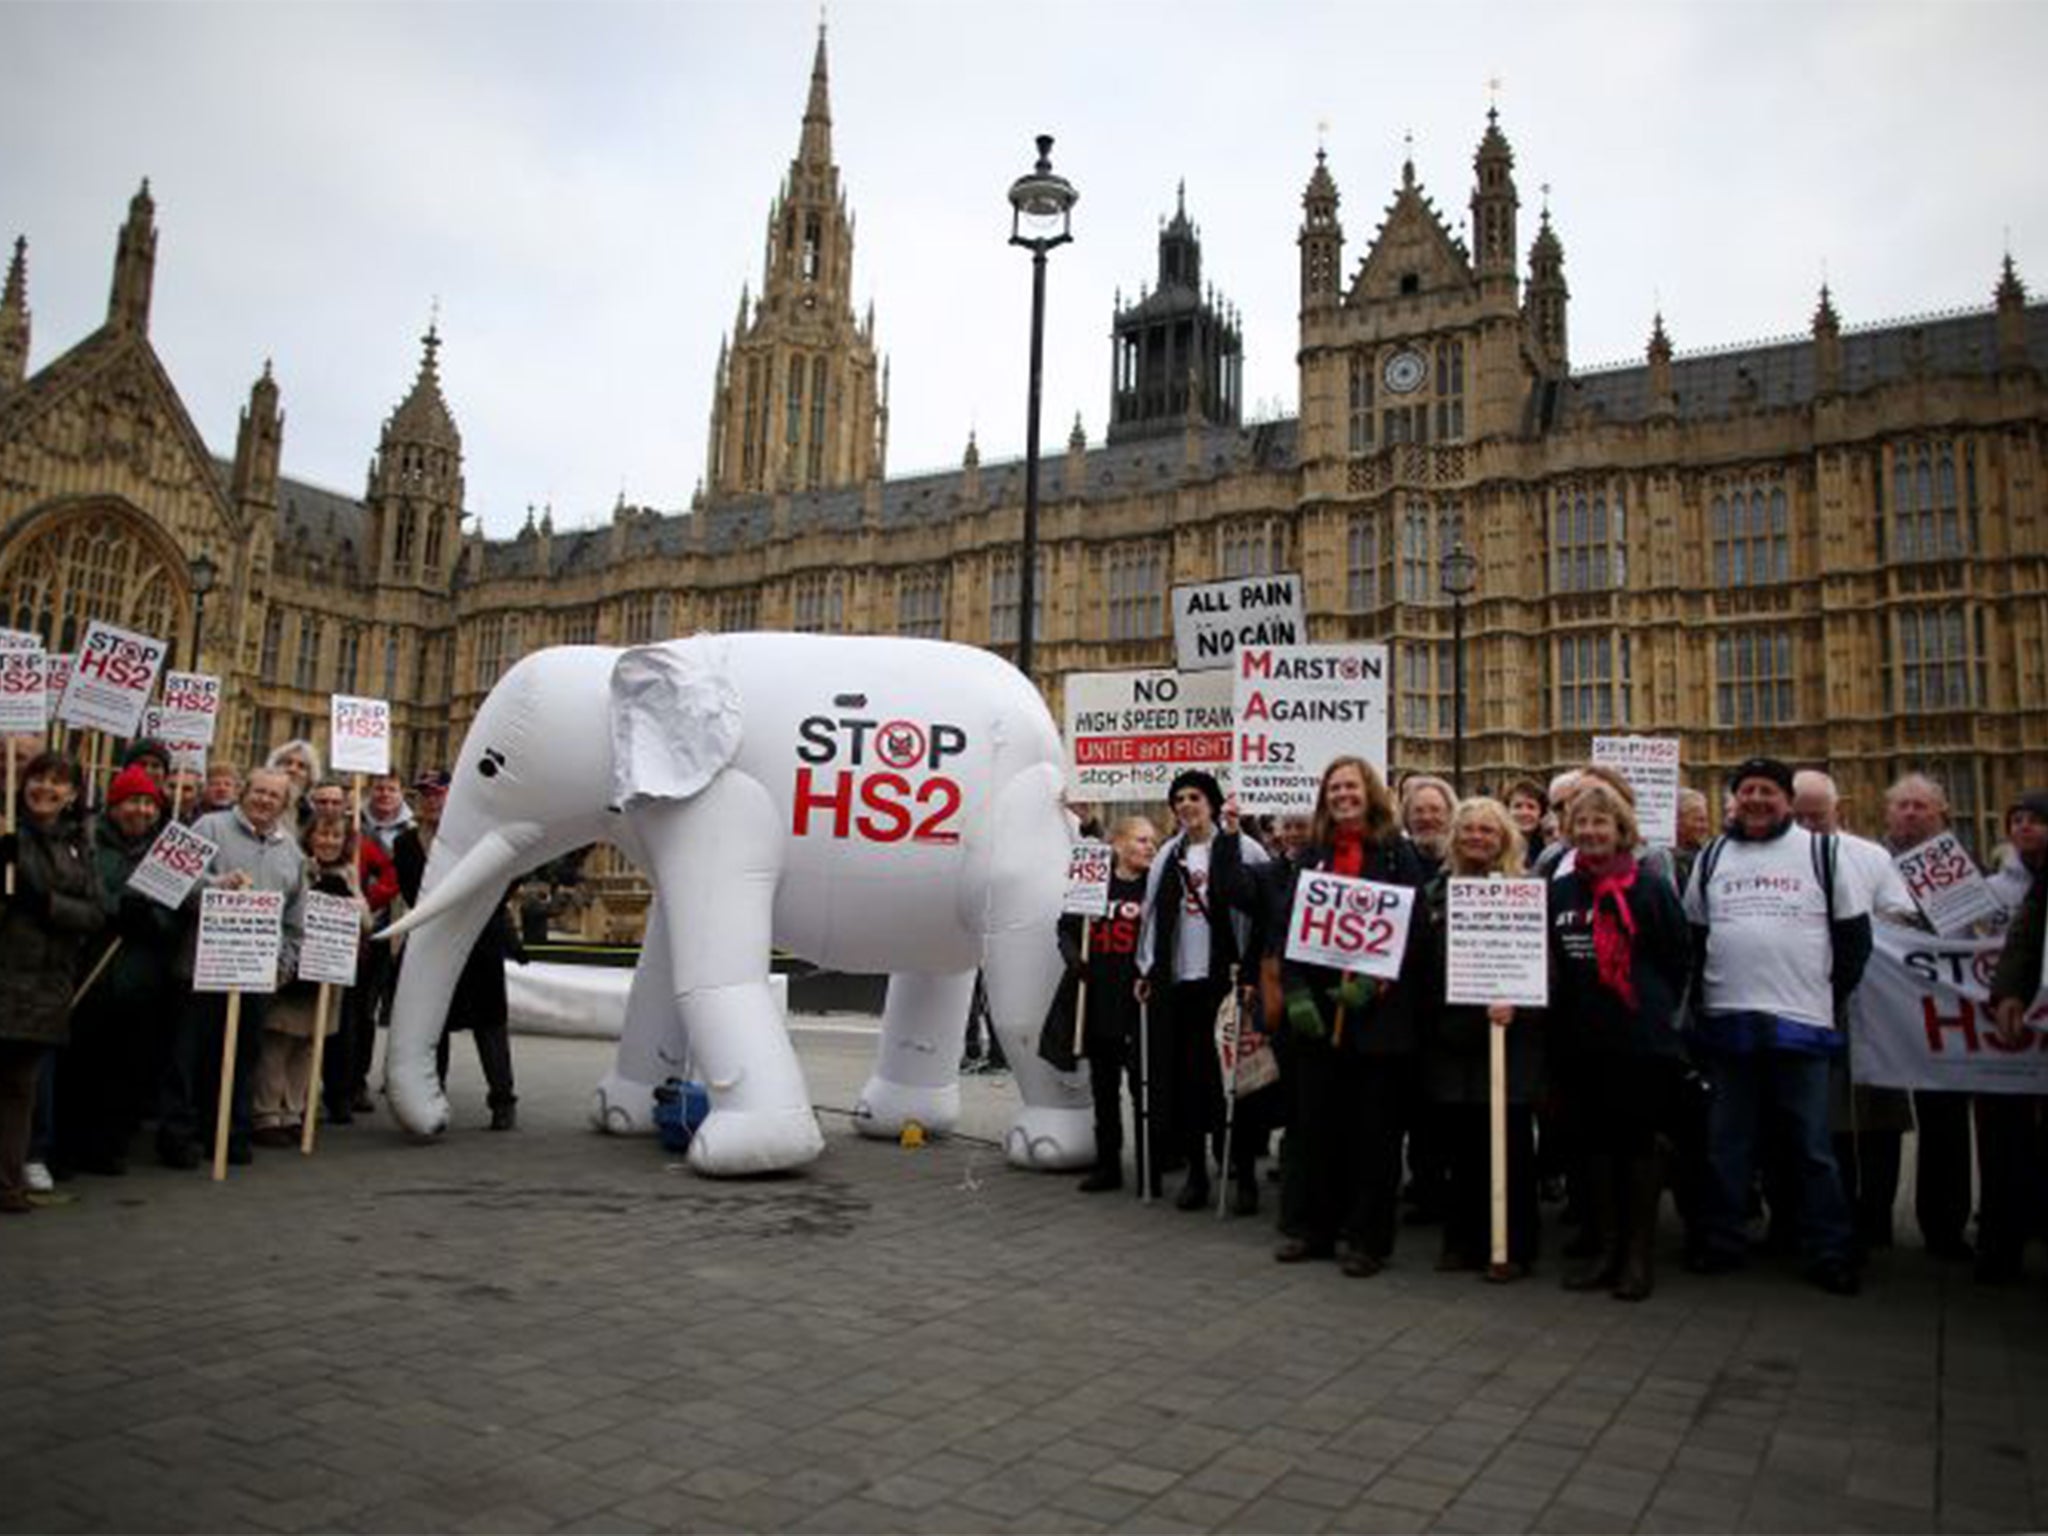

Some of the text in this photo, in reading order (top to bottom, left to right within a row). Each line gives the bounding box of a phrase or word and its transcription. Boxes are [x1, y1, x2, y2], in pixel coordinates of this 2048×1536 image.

[1187, 582, 1293, 615] ALL PAIN
[89, 631, 159, 663] STOP
[1197, 630, 1234, 656] NO
[0, 654, 42, 670] TOP
[79, 649, 151, 691] HS2
[1243, 650, 1382, 679] MARSTON
[3, 672, 42, 693] S2
[1134, 678, 1178, 702] NO
[165, 691, 215, 713] HS2
[1244, 691, 1369, 721] AGAINST
[1076, 711, 1118, 732] HIGH
[1121, 709, 1179, 731] SPEED
[796, 716, 967, 769] STOP
[1078, 736, 1231, 761] UNITE and FIGHT
[1241, 733, 1295, 762] HS2
[792, 768, 962, 843] HS2
[153, 839, 204, 878] HS2
[1069, 862, 1107, 882] HS2
[1901, 836, 1955, 878] STOP
[1908, 855, 1973, 899] HS2
[1306, 880, 1399, 916] STOP
[1300, 907, 1394, 955] HS2
